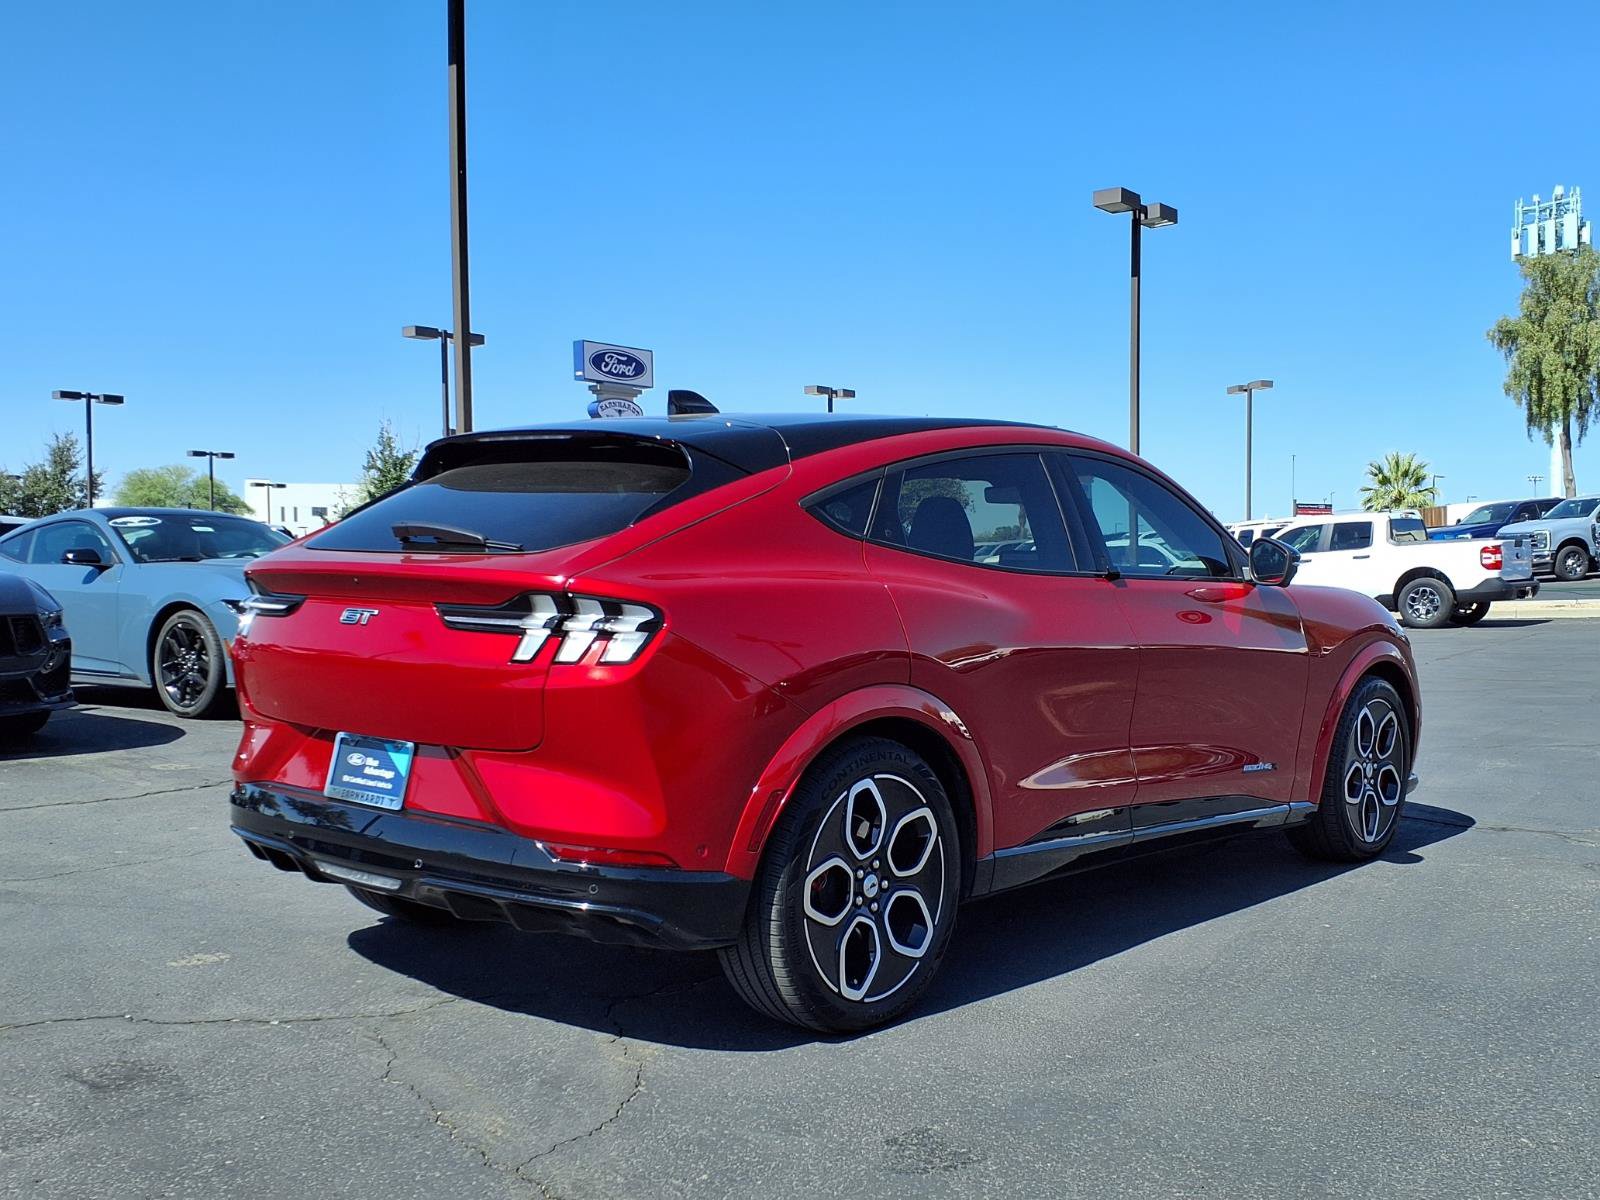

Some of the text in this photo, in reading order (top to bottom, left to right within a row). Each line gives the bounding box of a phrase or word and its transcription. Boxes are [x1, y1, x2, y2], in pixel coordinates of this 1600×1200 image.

[601, 353, 636, 376] Ford
[339, 607, 379, 625] GT
[822, 751, 911, 801] CONTINENTAL
